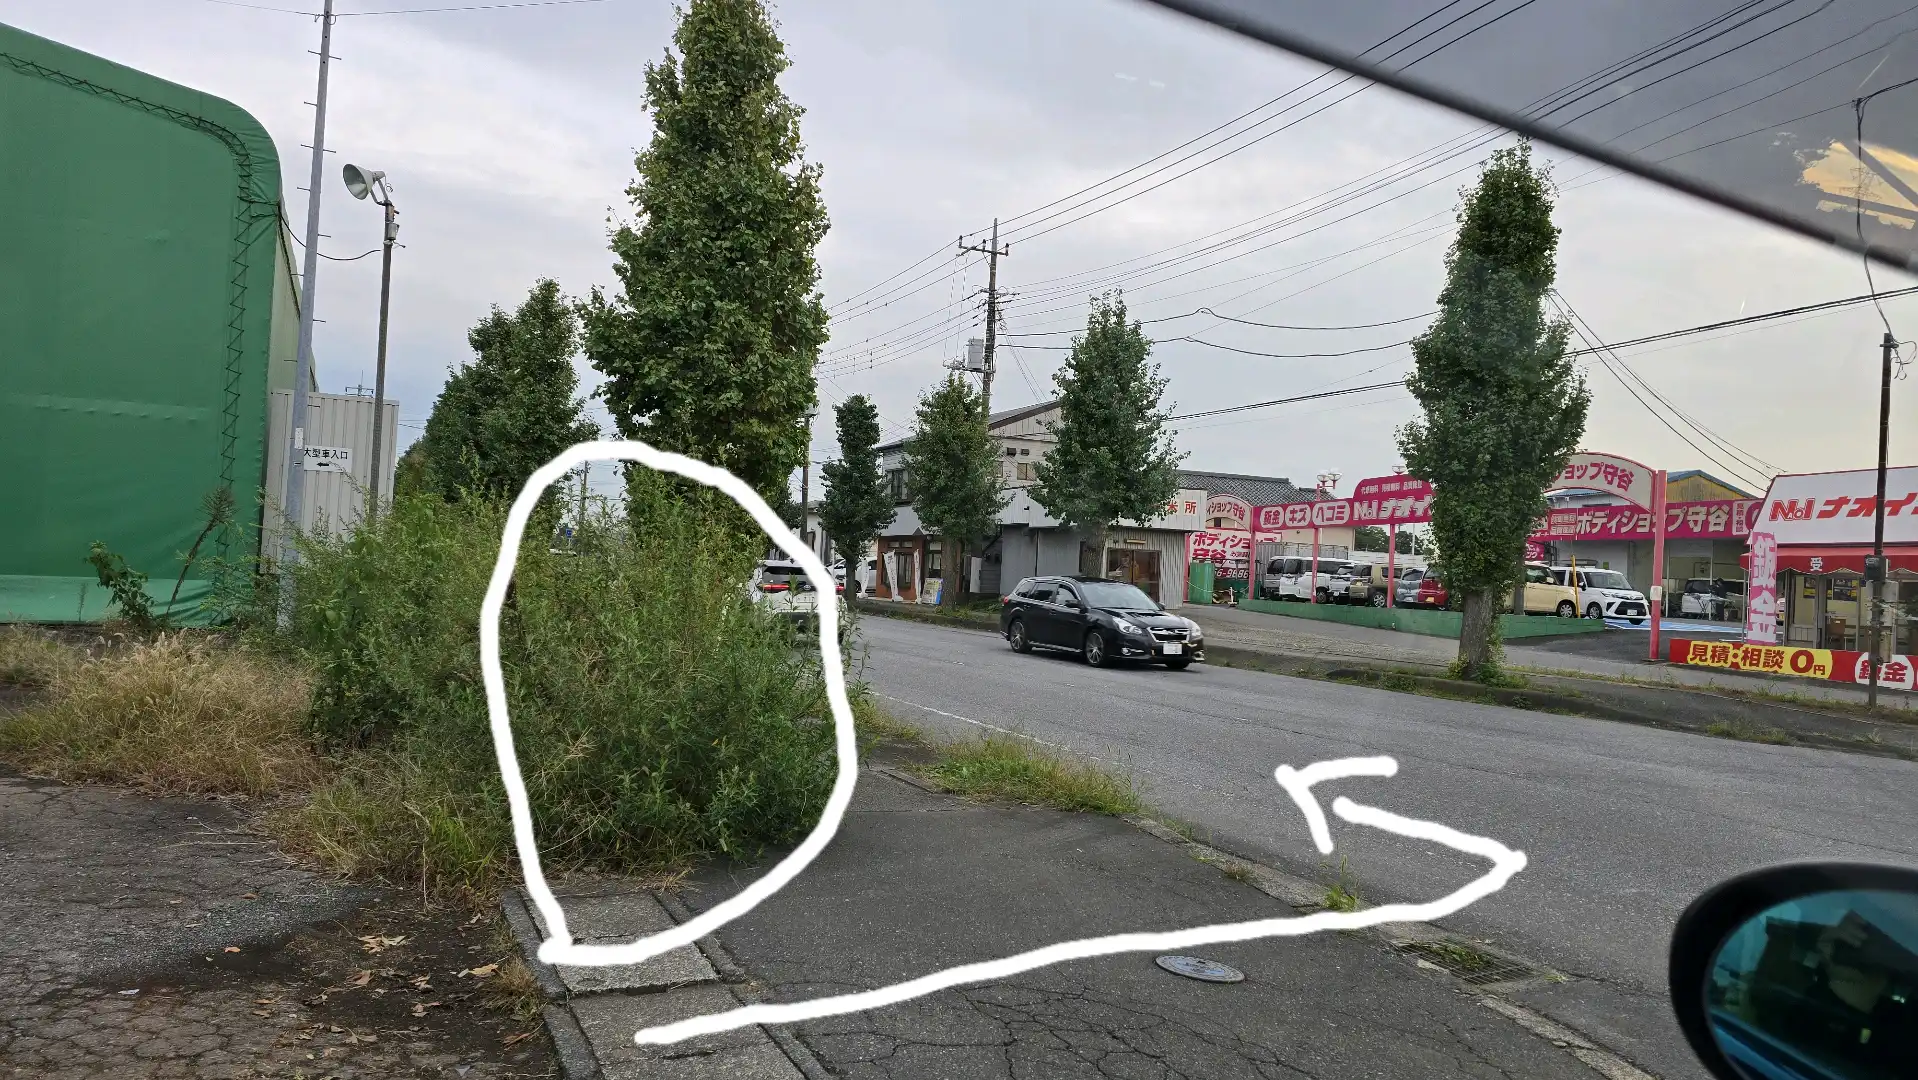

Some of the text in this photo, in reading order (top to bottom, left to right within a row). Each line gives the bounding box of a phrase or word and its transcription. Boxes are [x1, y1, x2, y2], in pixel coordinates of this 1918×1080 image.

[304, 448, 348, 460] 大型車入口
[1552, 461, 1635, 492] ョップ守谷
[1316, 504, 1347, 522] ヘコミ
[1575, 503, 1728, 534] ボディショプ守谷
[1810, 556, 1824, 572] 受
